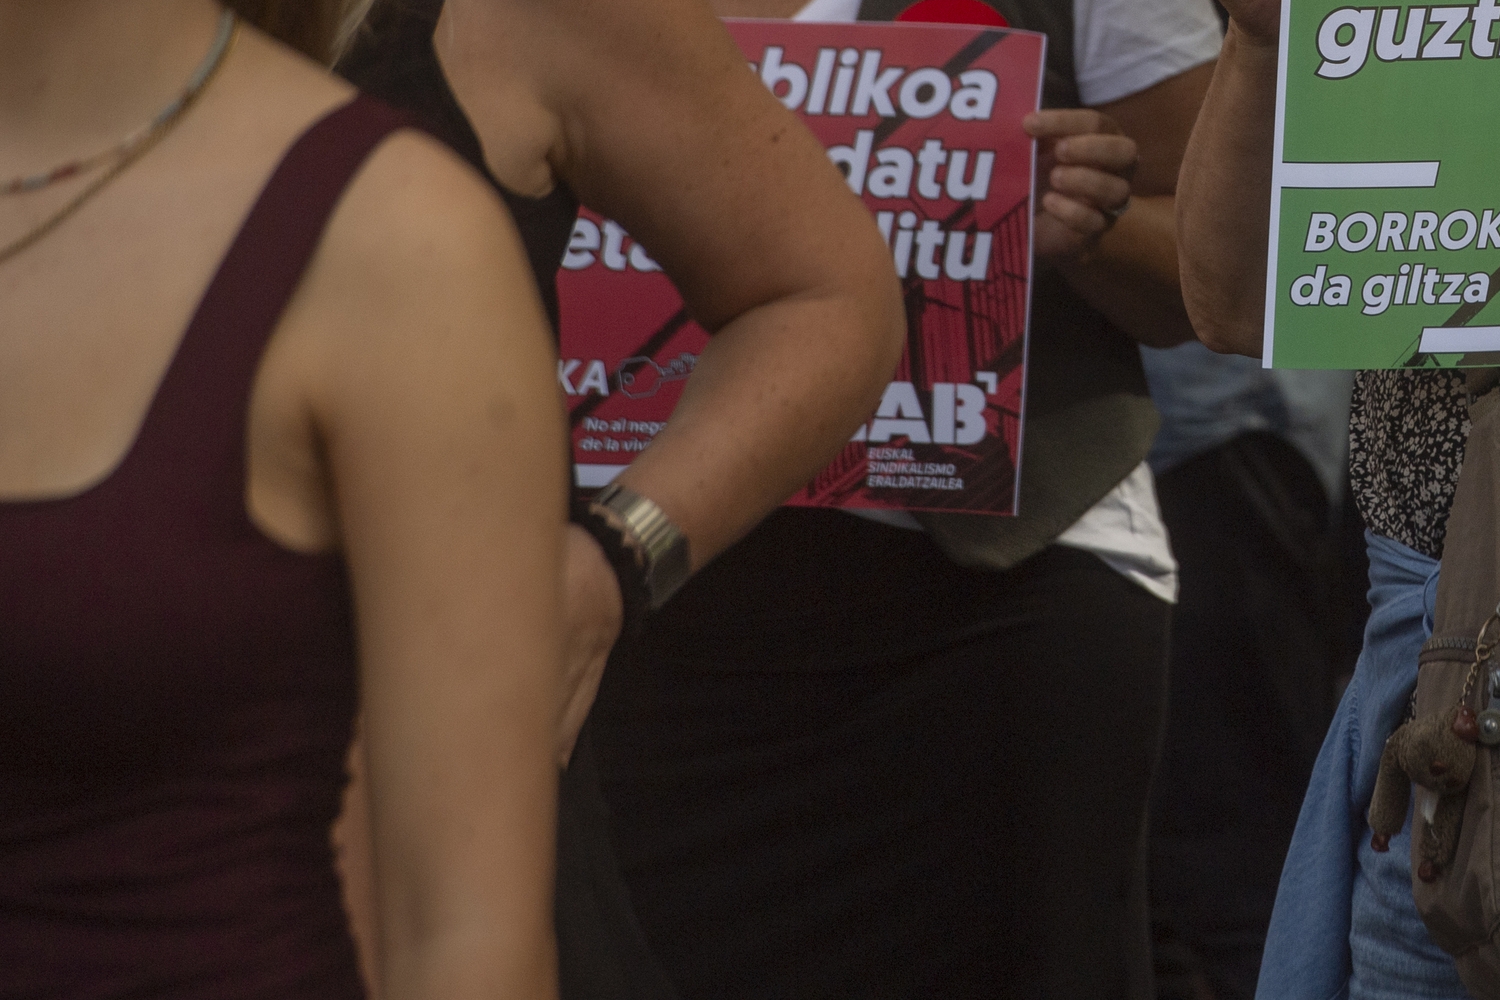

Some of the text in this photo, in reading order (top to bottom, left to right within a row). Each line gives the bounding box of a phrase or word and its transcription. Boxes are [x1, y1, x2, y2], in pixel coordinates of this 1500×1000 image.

[748, 45, 999, 121] blikoa
[1289, 263, 1491, 316] da giltza
[850, 380, 988, 446] AB
[584, 416, 609, 433] No
[611, 417, 627, 433] al
[580, 437, 603, 452] de
[604, 437, 620, 452] la
[867, 446, 915, 461] EUSKAL
[867, 460, 957, 477] SINDIKALISMO
[867, 475, 965, 491] ERALDATZAILEA
